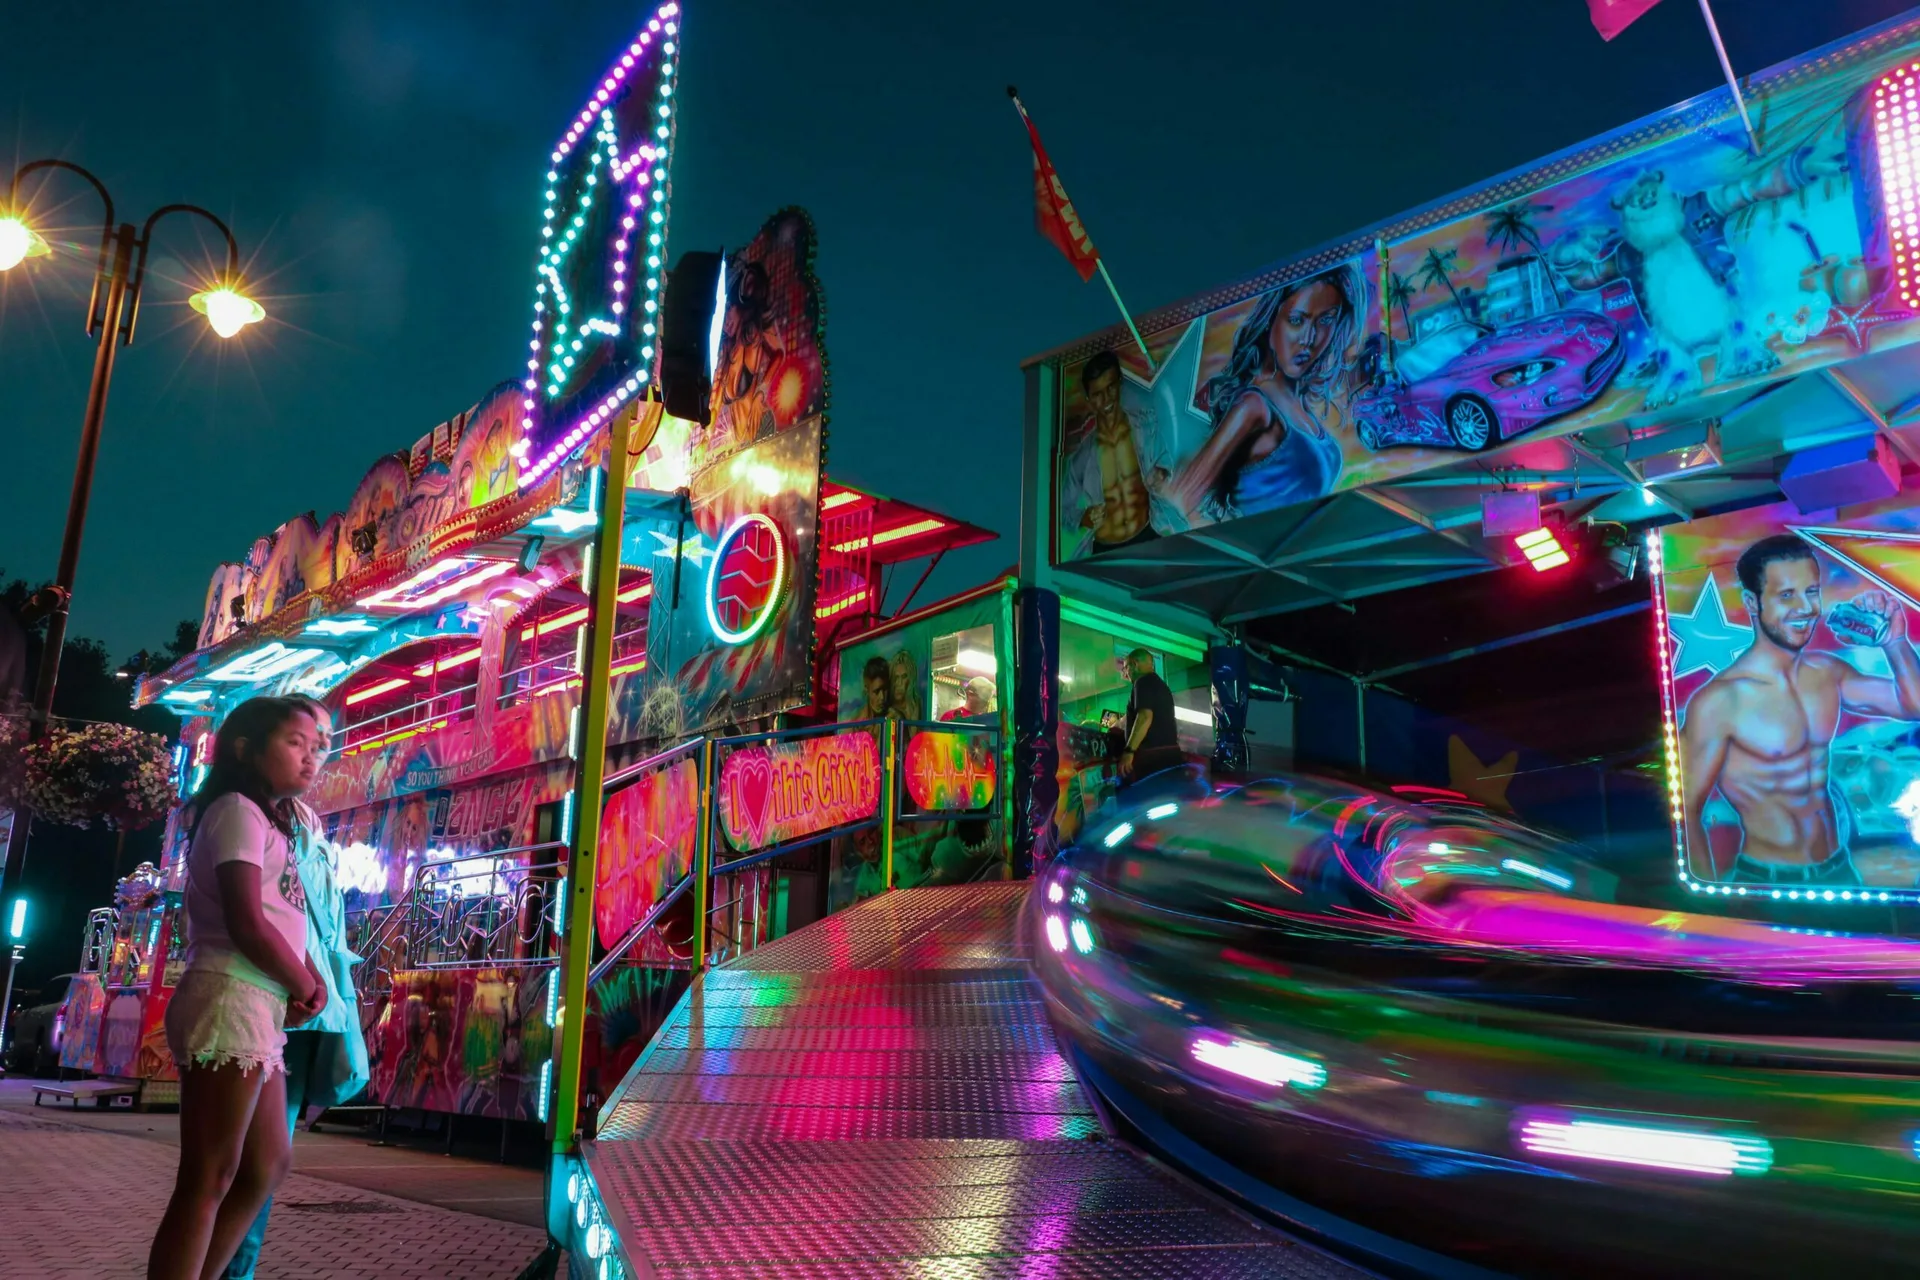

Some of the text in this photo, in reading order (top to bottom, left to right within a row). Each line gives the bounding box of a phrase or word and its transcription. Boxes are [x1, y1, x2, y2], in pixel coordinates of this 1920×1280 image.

[406, 751, 495, 787] SO YOU THINK YOU CAN
[728, 771, 742, 835] I
[772, 761, 814, 823] this
